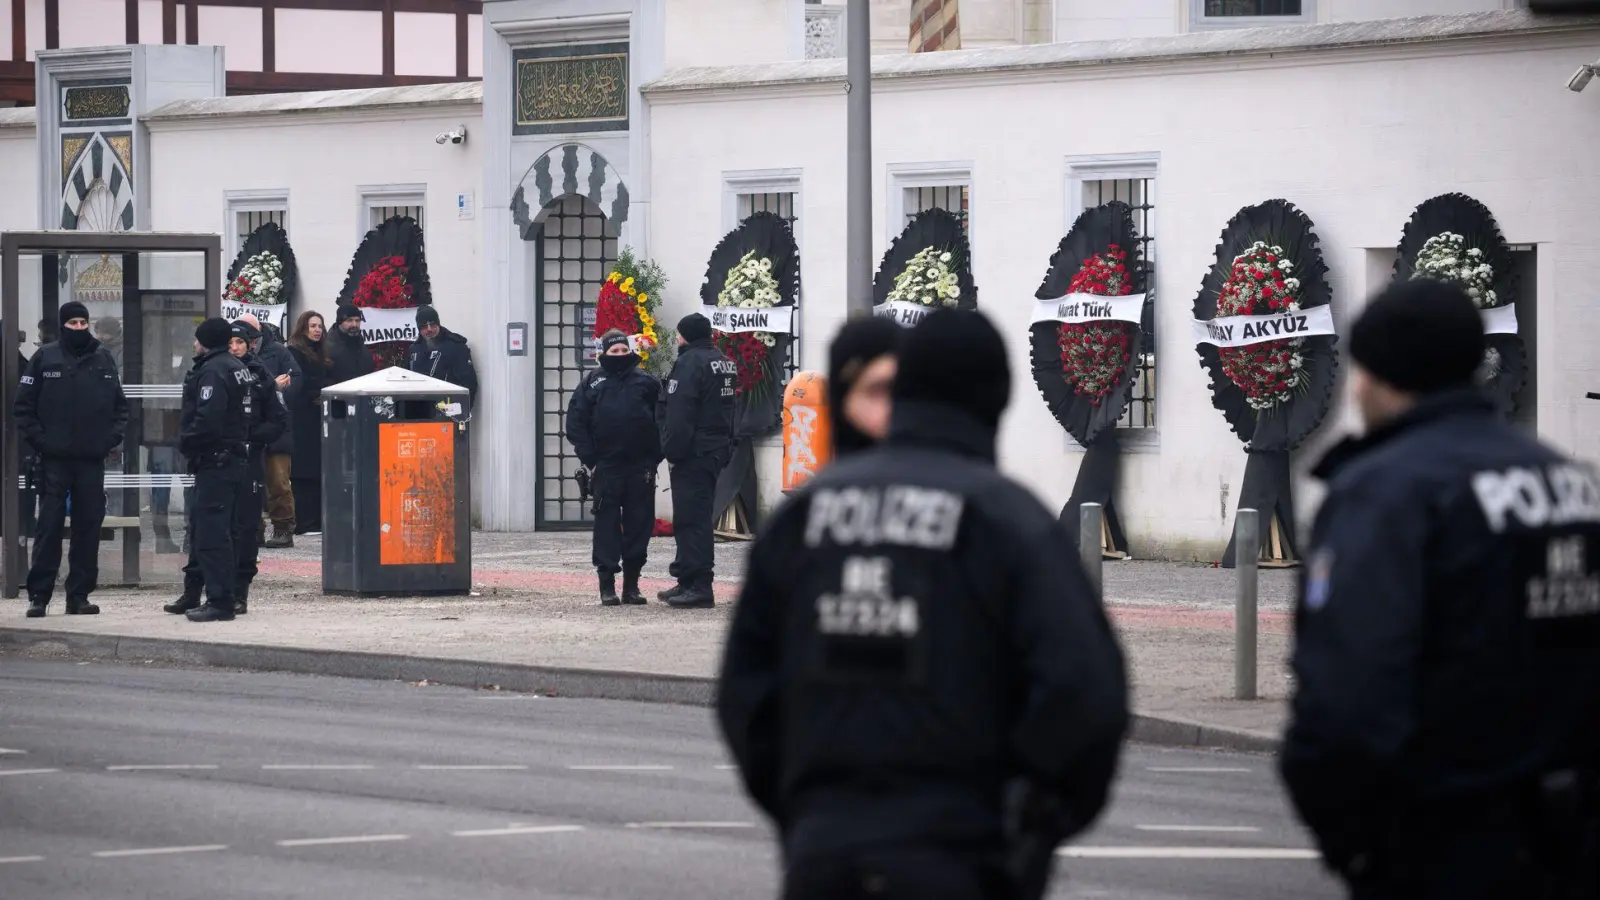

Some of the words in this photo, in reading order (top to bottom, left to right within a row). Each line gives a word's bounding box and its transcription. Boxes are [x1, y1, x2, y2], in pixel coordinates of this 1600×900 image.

[730, 309, 768, 331] ŞAHİN
[1082, 301, 1112, 318] Türk
[1243, 314, 1309, 339] AKYÜZ
[804, 486, 963, 550] POLIZEI
